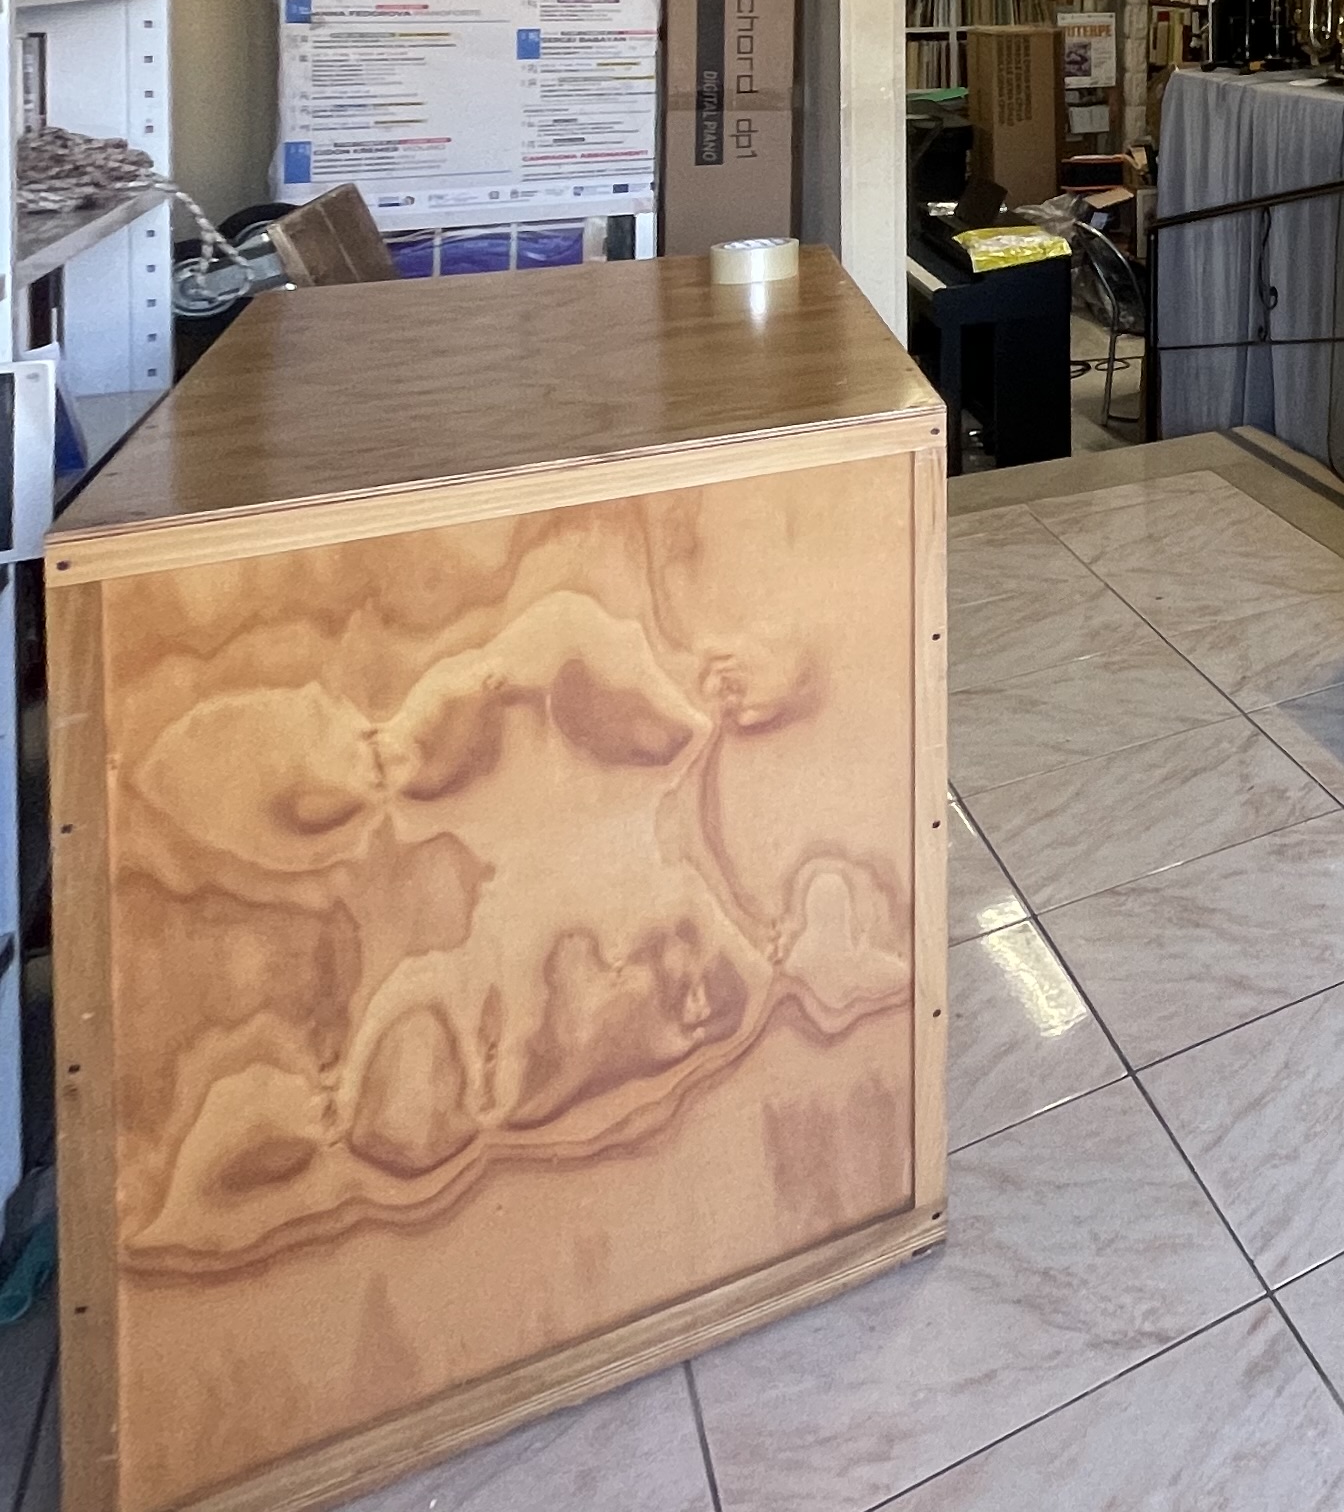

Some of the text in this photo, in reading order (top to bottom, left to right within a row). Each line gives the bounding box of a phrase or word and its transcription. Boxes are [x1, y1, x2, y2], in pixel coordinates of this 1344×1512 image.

[702, 70, 717, 161] DIGITAL PIANO
[731, 118, 758, 159] dp1
